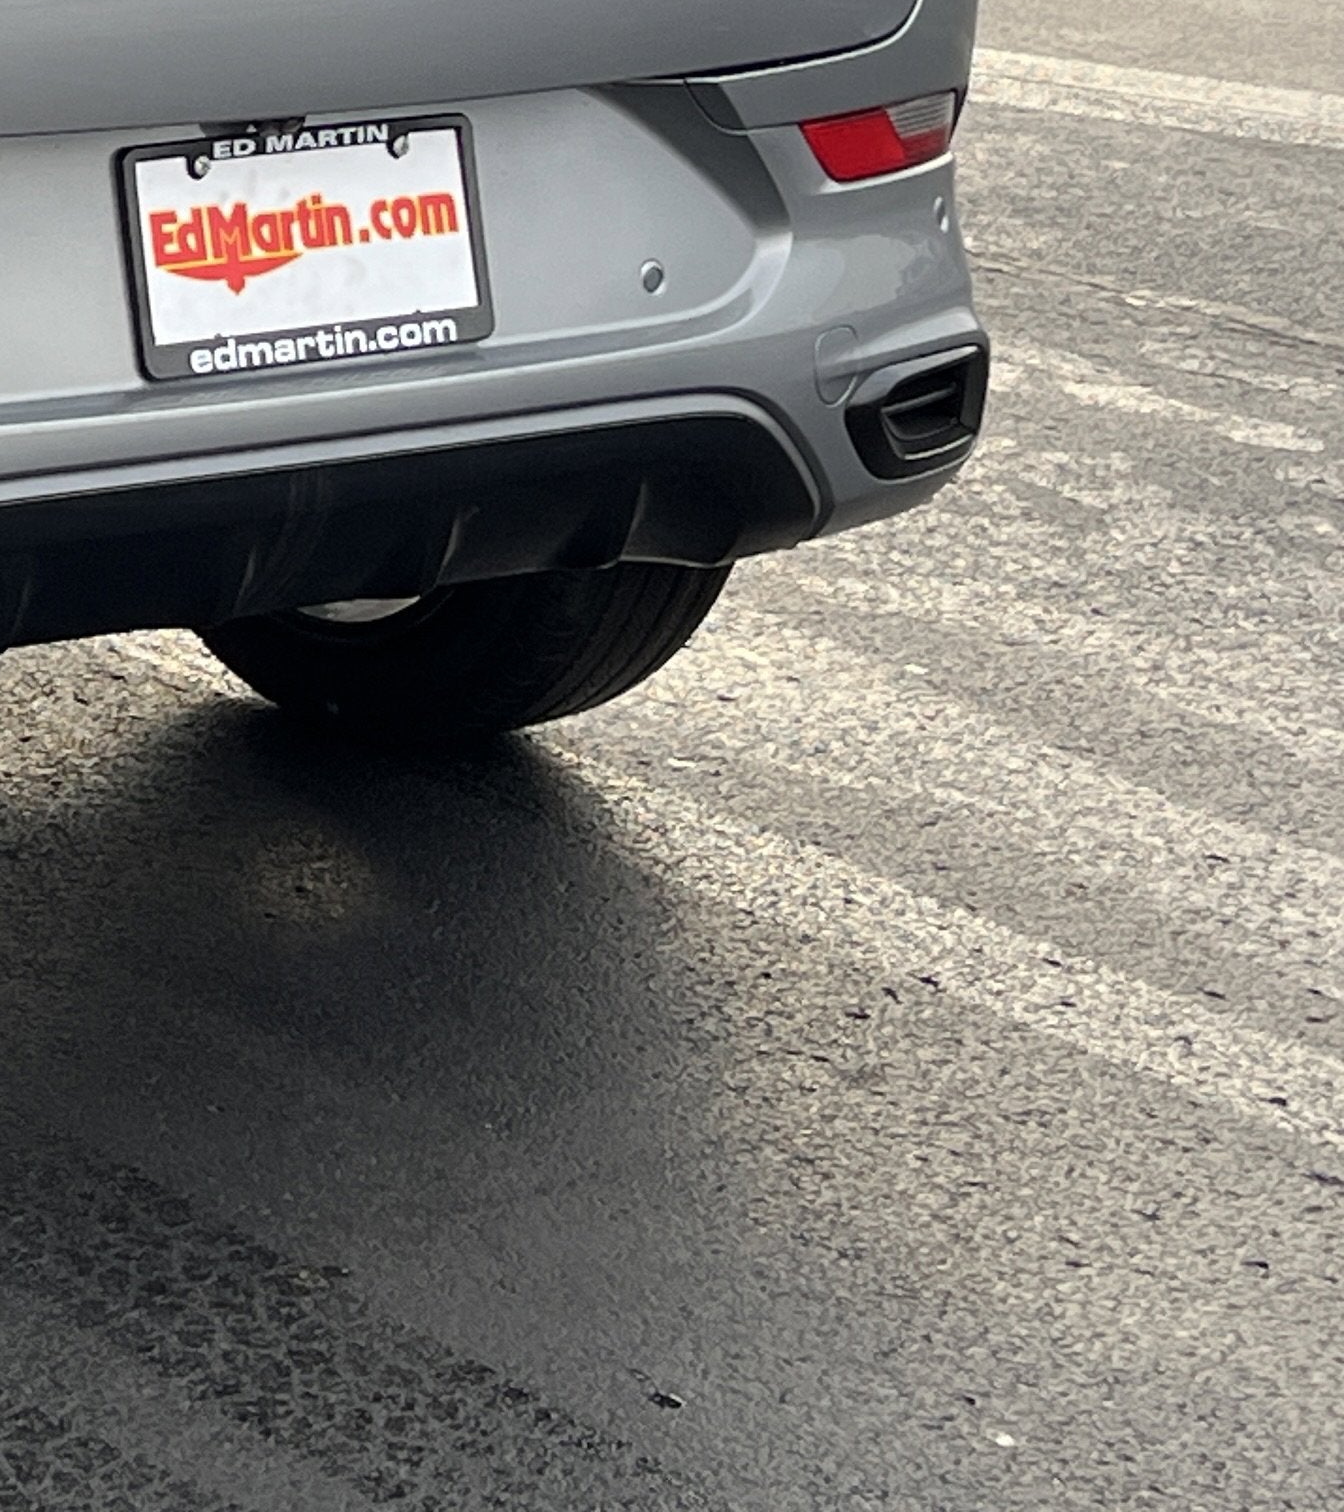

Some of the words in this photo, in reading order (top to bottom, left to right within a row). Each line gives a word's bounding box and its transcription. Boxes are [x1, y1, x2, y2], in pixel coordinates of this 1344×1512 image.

[212, 138, 256, 160] ED
[264, 123, 390, 154] MARTIN
[189, 317, 458, 375] edmartin.com
